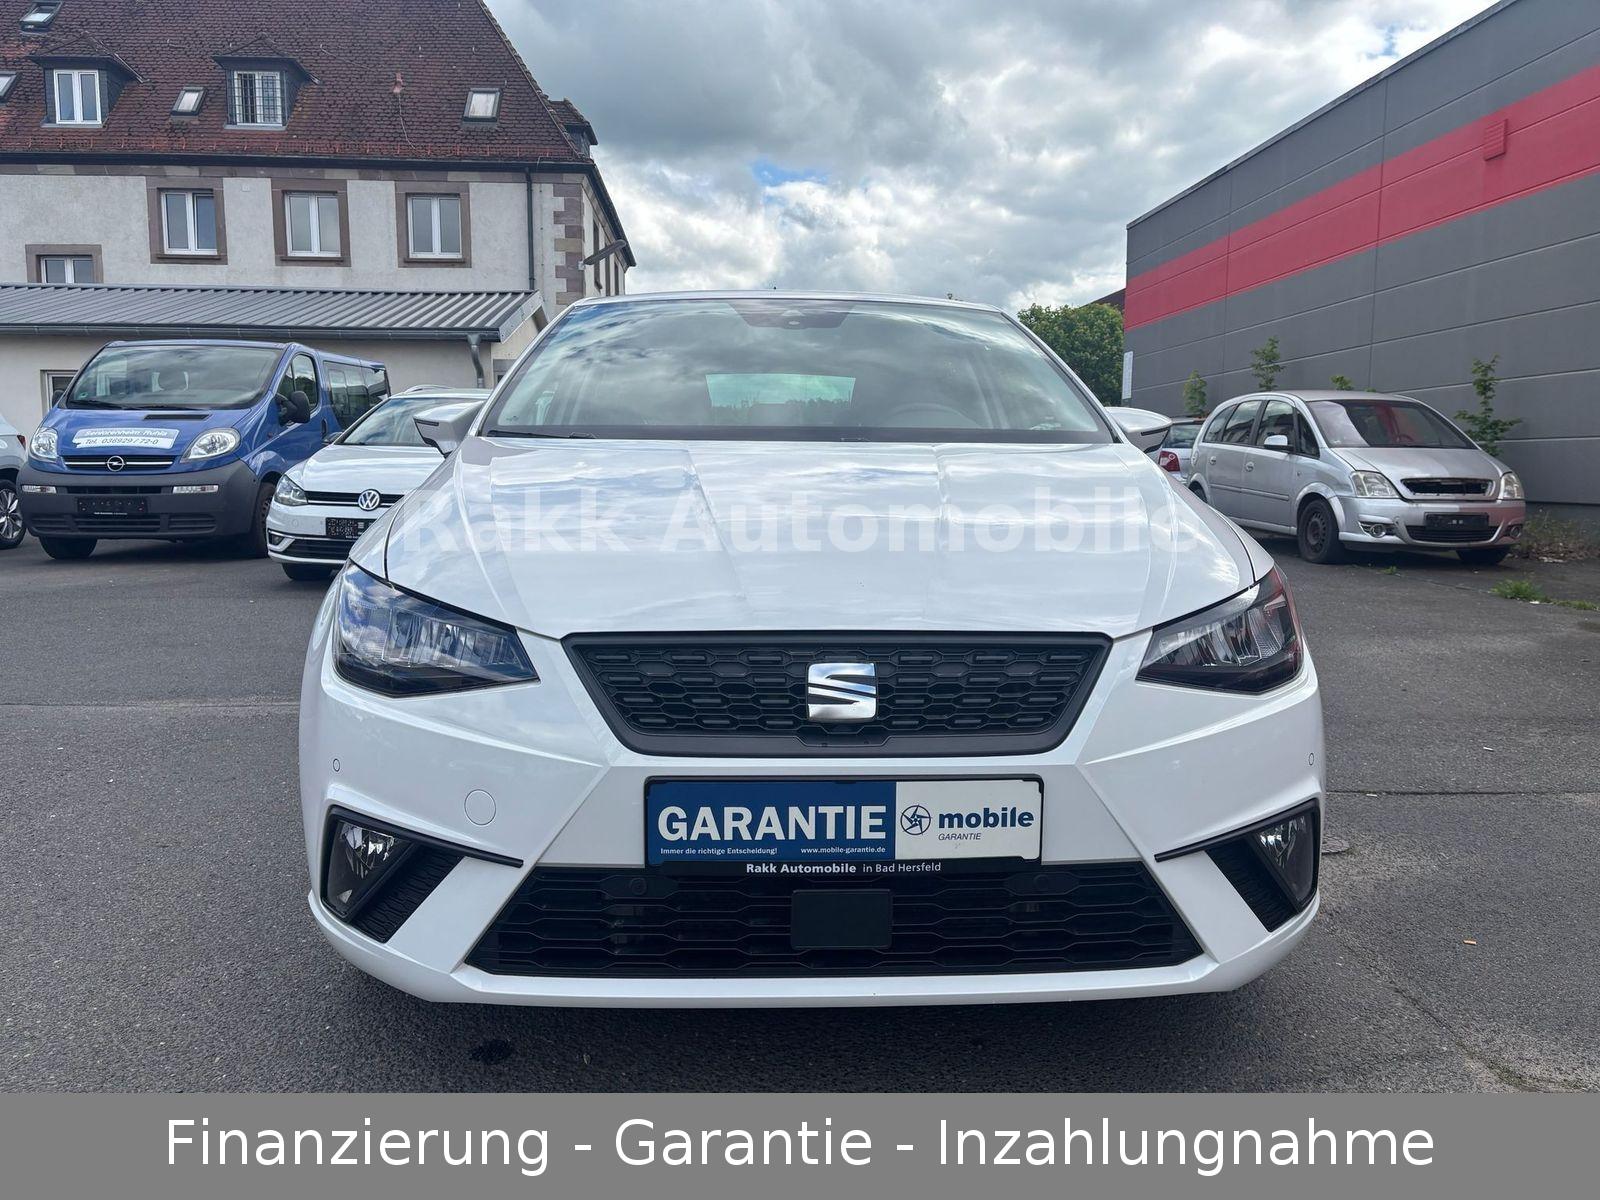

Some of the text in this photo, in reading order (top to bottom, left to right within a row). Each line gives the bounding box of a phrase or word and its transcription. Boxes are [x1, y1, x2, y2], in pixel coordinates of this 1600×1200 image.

[938, 806, 1035, 829] mobile
[658, 805, 886, 841] GARANTIE
[938, 832, 982, 841] GARANTIE
[660, 847, 778, 856] Immer die richtige Entscheidung!
[800, 846, 886, 854] www.mobile-garantie.de
[746, 862, 942, 874] Rakk Automobile in Bad Hersfeld
